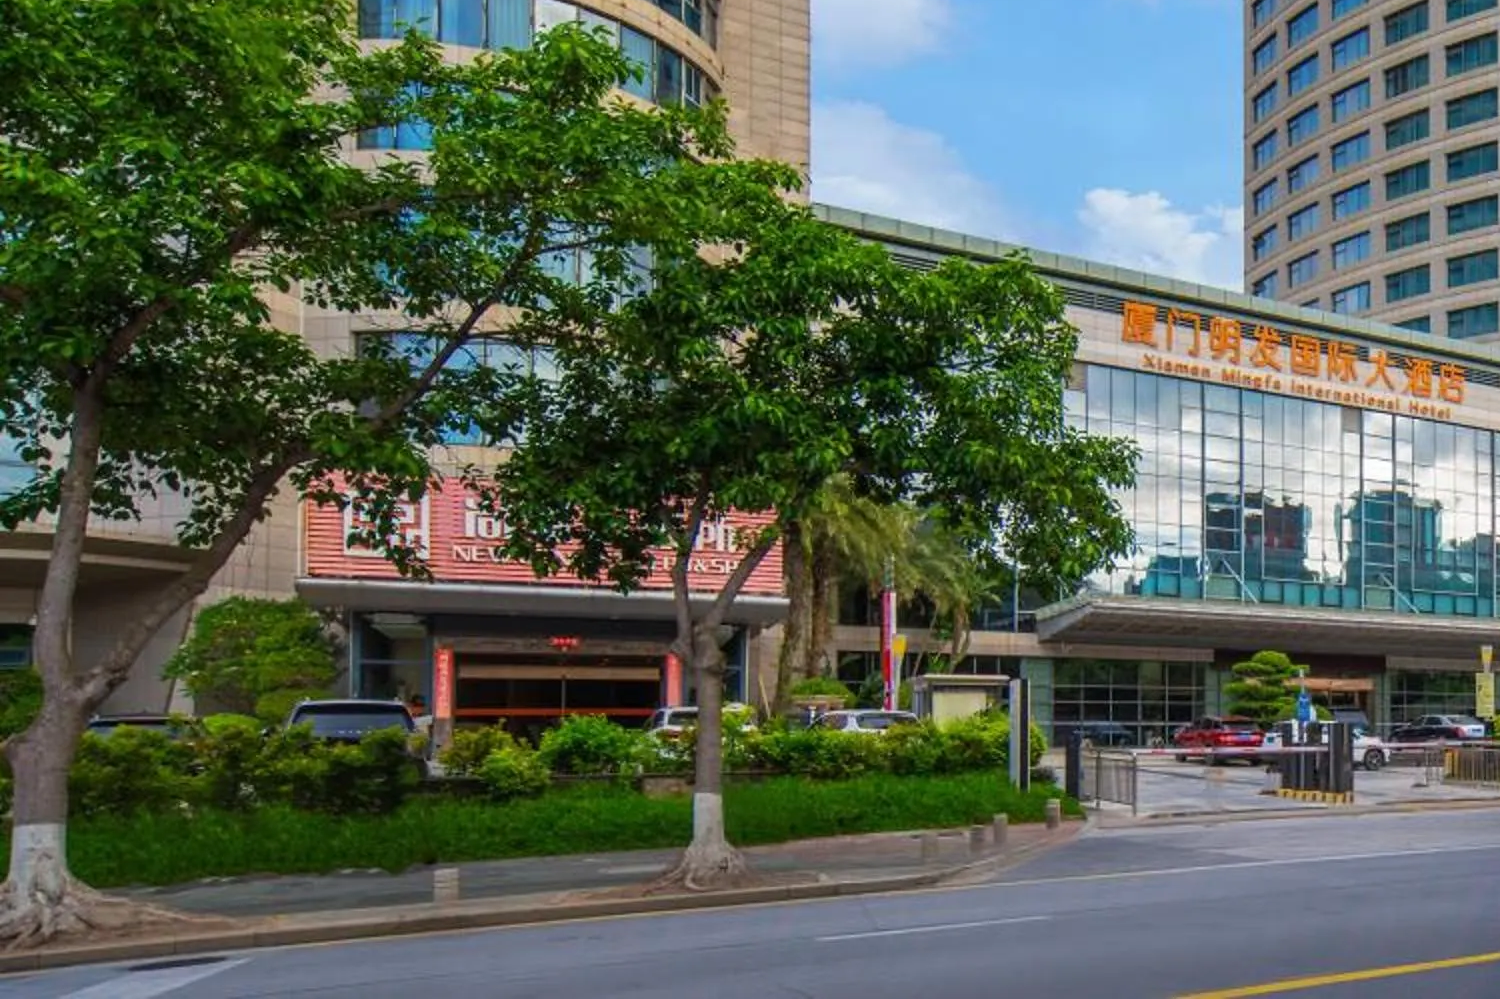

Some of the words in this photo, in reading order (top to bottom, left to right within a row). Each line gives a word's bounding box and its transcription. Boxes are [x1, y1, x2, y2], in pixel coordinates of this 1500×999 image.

[1121, 300, 1466, 403] 厦门明发国际大酒店
[1143, 353, 1211, 378] Xiamen
[1221, 368, 1281, 390] Mingfa
[1291, 379, 1400, 410] International
[1409, 400, 1453, 419] Hotel
